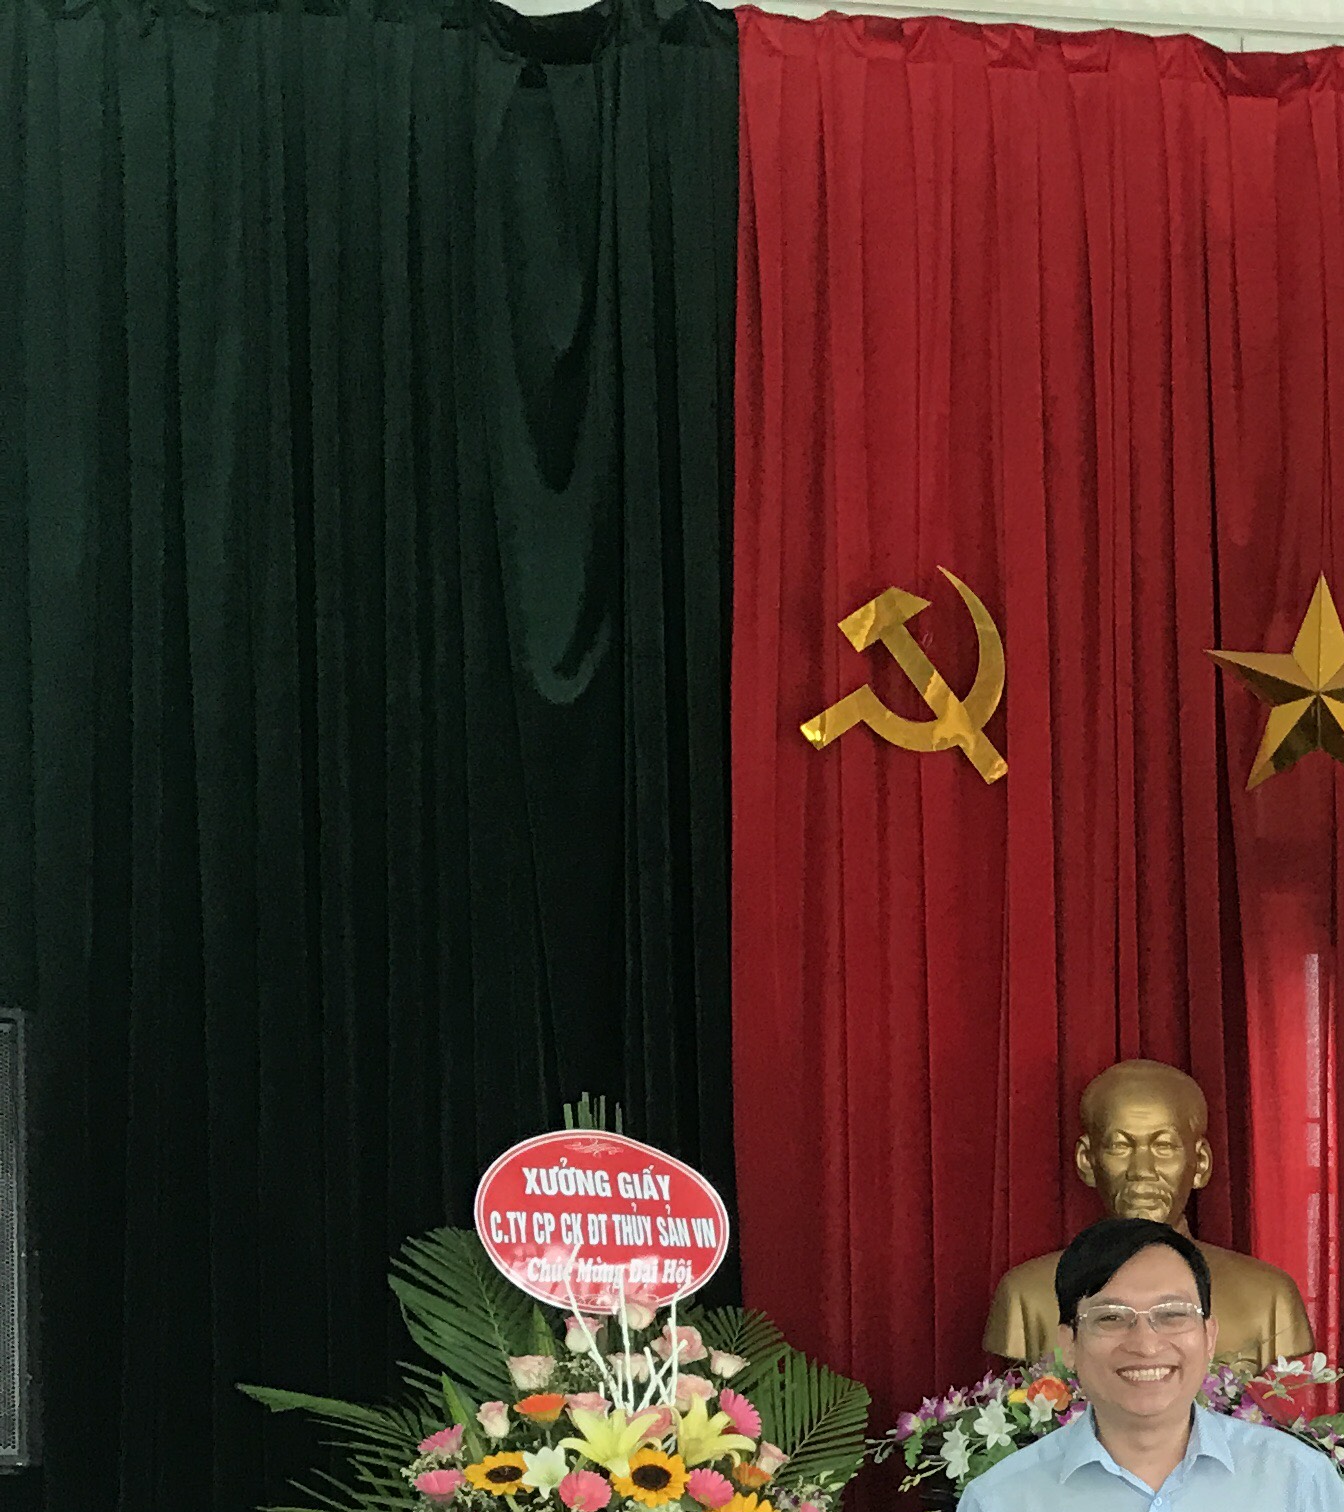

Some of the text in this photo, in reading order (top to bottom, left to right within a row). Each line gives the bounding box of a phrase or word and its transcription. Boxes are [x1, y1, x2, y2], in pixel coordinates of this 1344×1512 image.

[522, 1157, 670, 1200] XƯỞNG GIẤY
[490, 1202, 717, 1248] C.TY CP CK ĐT THỦY SẢN VN
[661, 1258, 692, 1286] Hội
